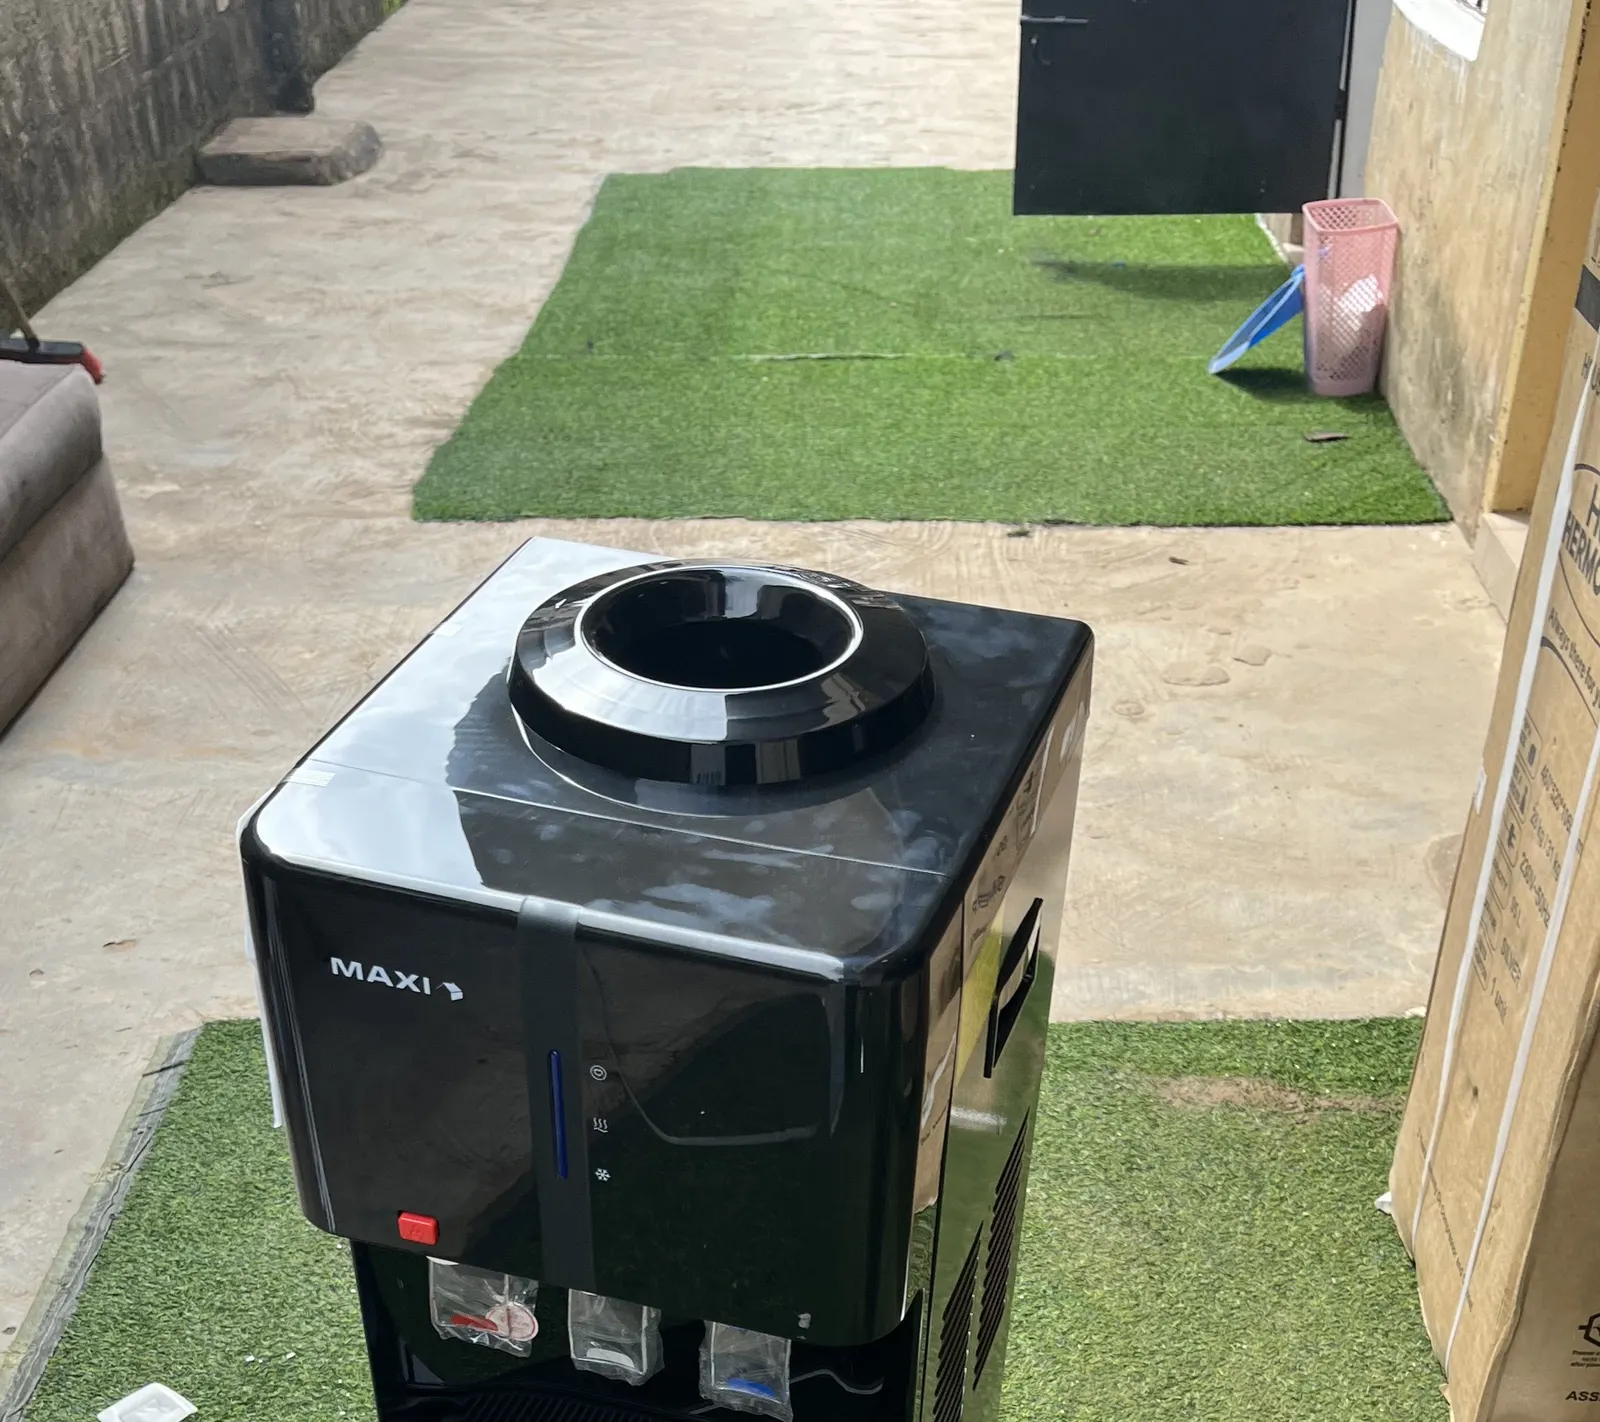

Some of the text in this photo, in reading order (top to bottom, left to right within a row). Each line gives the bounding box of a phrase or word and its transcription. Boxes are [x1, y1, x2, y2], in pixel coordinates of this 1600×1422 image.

[1547, 607, 1571, 652] Always
[1568, 641, 1586, 679] there
[1585, 665, 1596, 695] for
[329, 956, 432, 996] MAXI
[1565, 1390, 1600, 1402] ASS
